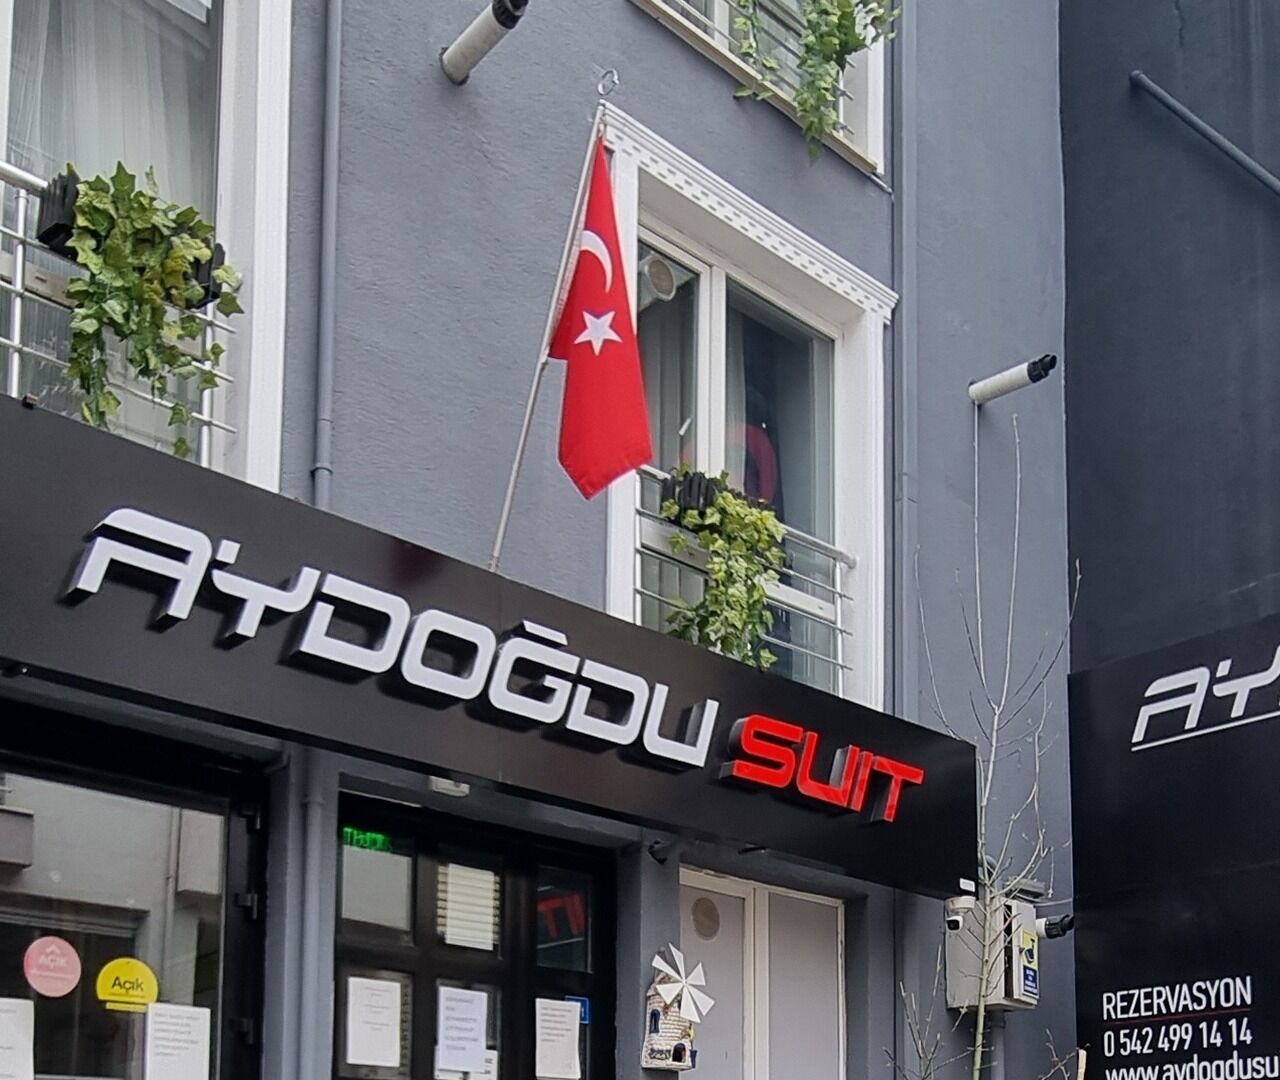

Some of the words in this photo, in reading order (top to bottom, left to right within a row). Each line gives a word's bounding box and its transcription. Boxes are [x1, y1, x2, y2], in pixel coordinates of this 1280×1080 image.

[68, 506, 719, 770] AYDOĞDU
[726, 712, 925, 822] SUIT
[111, 975, 144, 993] Açık
[1102, 975, 1252, 1021] REZERVASYON
[1103, 1030, 1115, 1057] 0
[1120, 1026, 1153, 1056] 542
[1157, 1023, 1193, 1052] 499
[1198, 1019, 1223, 1049] 14
[1228, 1016, 1253, 1046] 14
